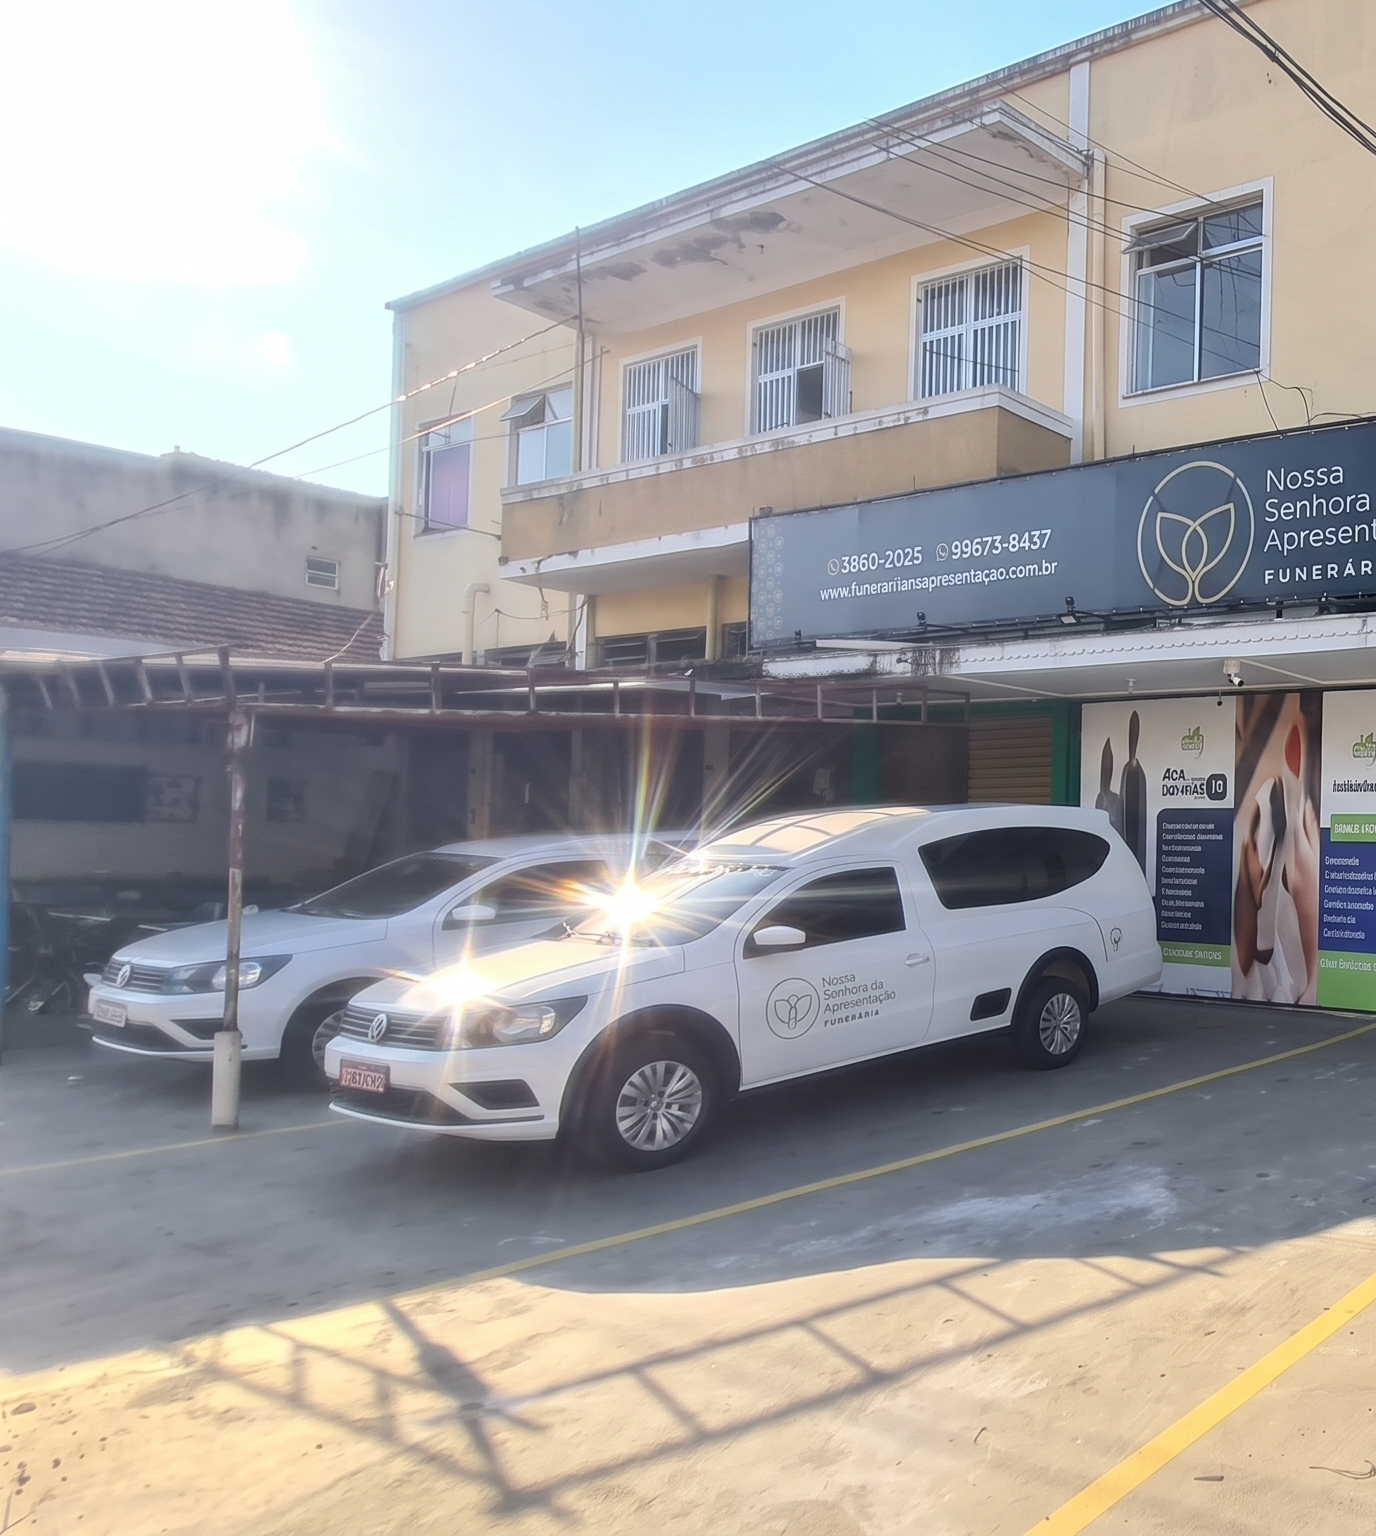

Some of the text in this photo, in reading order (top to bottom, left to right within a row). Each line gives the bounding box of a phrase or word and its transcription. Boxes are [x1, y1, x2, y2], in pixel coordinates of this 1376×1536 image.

[1266, 465, 1344, 492] Nossa
[1264, 493, 1370, 522] Senhora
[841, 529, 1052, 574] 3860-2025 99673-8437
[821, 973, 856, 988] Nossa
[870, 979, 884, 991] da
[823, 990, 896, 1015] Apresentação
